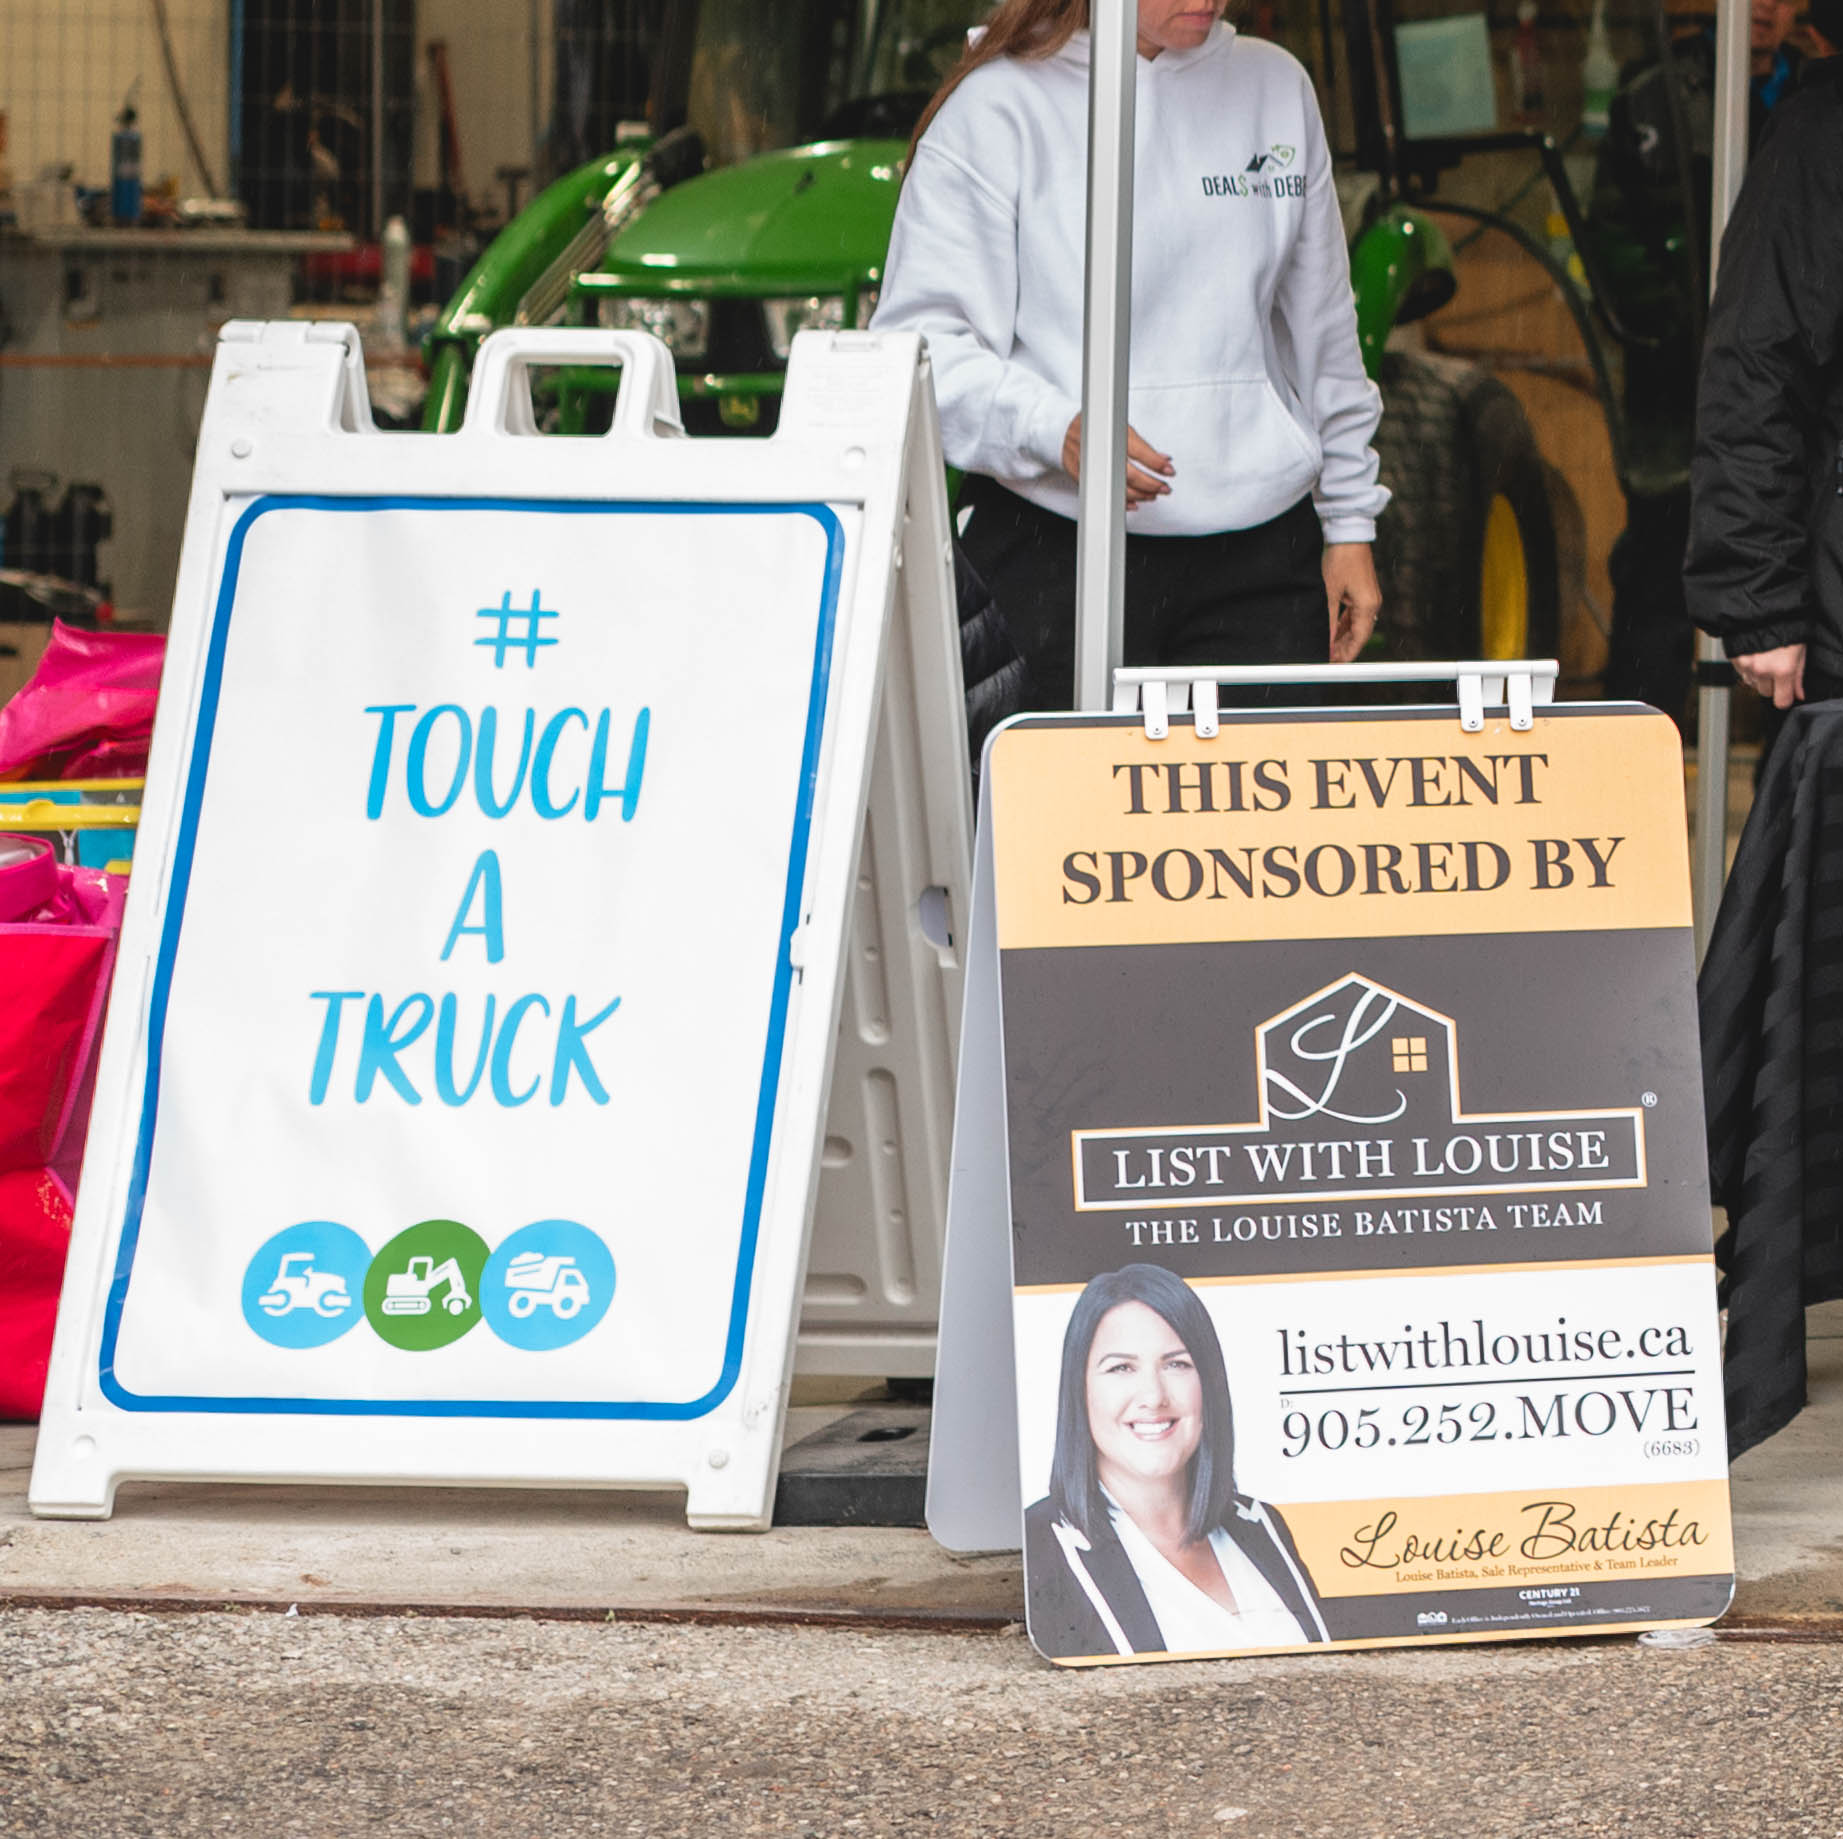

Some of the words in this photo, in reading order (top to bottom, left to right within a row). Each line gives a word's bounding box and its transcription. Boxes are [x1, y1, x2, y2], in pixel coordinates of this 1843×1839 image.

[1252, 180, 1273, 199] with
[475, 589, 559, 668] #
[363, 703, 651, 822] TOUCH
[1113, 758, 1291, 815] THIS
[1308, 753, 1549, 810] EVENT
[1062, 839, 1511, 905] SPONSORED
[1528, 836, 1625, 891] BY
[439, 848, 504, 963] A
[308, 990, 622, 1107] TRUCK
[1114, 1145, 1231, 1190] LIST
[1247, 1138, 1394, 1183] WITH
[1411, 1130, 1610, 1178] LOUISE
[1125, 1217, 1200, 1246] THE
[1212, 1212, 1342, 1241] LOUISE
[1354, 1207, 1497, 1237] BATISTA
[1508, 1201, 1604, 1230] TEAM
[1278, 1317, 1693, 1377] listwithlouise.ca
[1281, 1387, 1699, 1458] 905.252.MOVE
[1643, 1438, 1700, 1459] (6683)
[1339, 1510, 1511, 1571] Louise
[1520, 1500, 1711, 1561] Batista
[1395, 1570, 1433, 1583] Louise
[1436, 1567, 1479, 1581] Batista,
[1482, 1565, 1506, 1578] Sale
[1508, 1561, 1591, 1578] Representative
[1593, 1560, 1602, 1571] &
[1605, 1558, 1636, 1571] Team
[1639, 1556, 1679, 1568] Leader
[1519, 1588, 1569, 1601] CENTURY
[1569, 1587, 1581, 1598] 21
